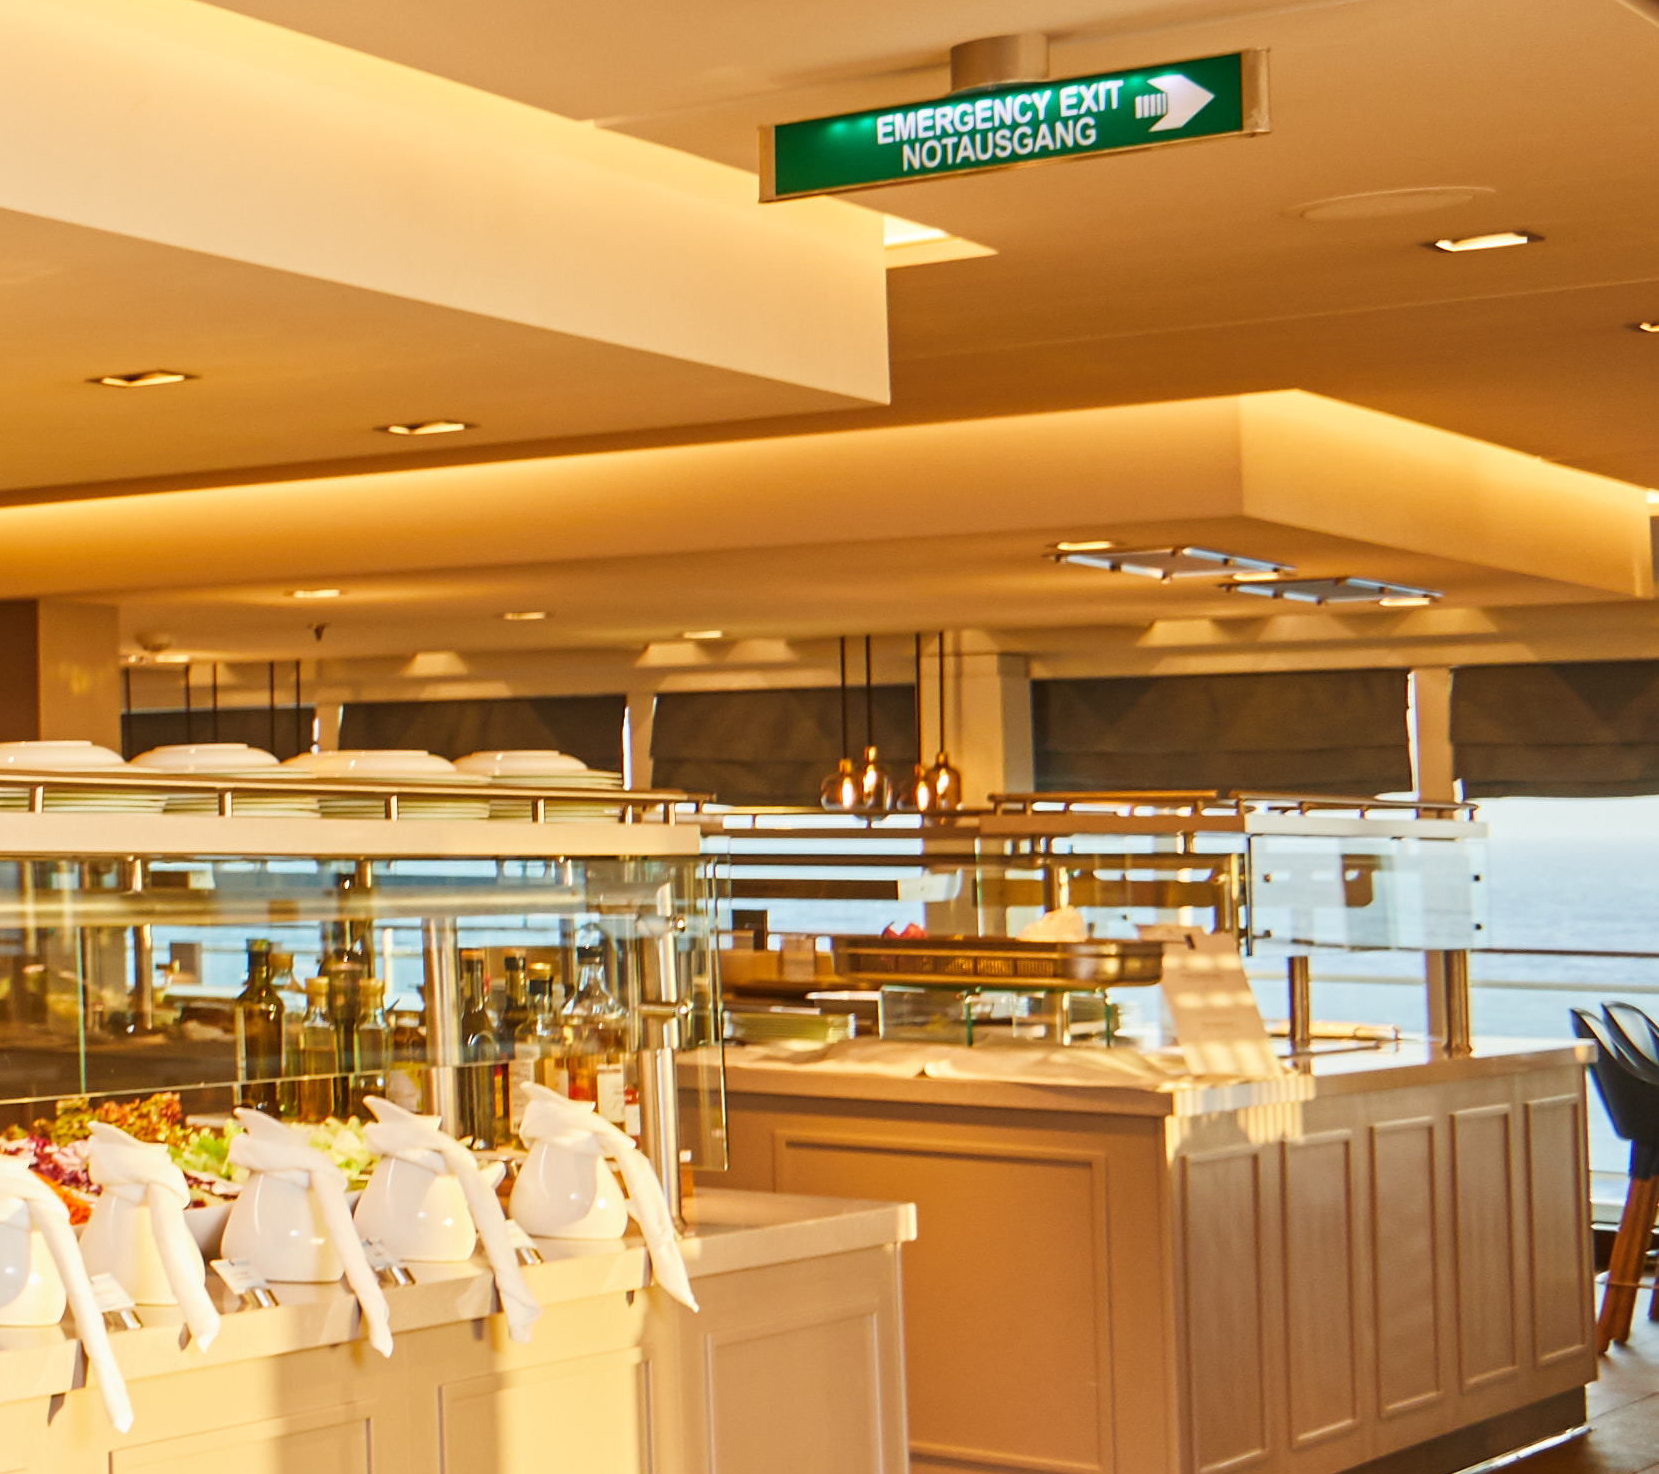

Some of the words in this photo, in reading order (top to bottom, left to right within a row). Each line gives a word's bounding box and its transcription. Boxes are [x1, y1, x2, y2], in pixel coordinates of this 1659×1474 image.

[877, 91, 1052, 145] EMERGENCY
[1059, 80, 1124, 116] EXIT
[903, 116, 1097, 171] NOTAUSGANG
